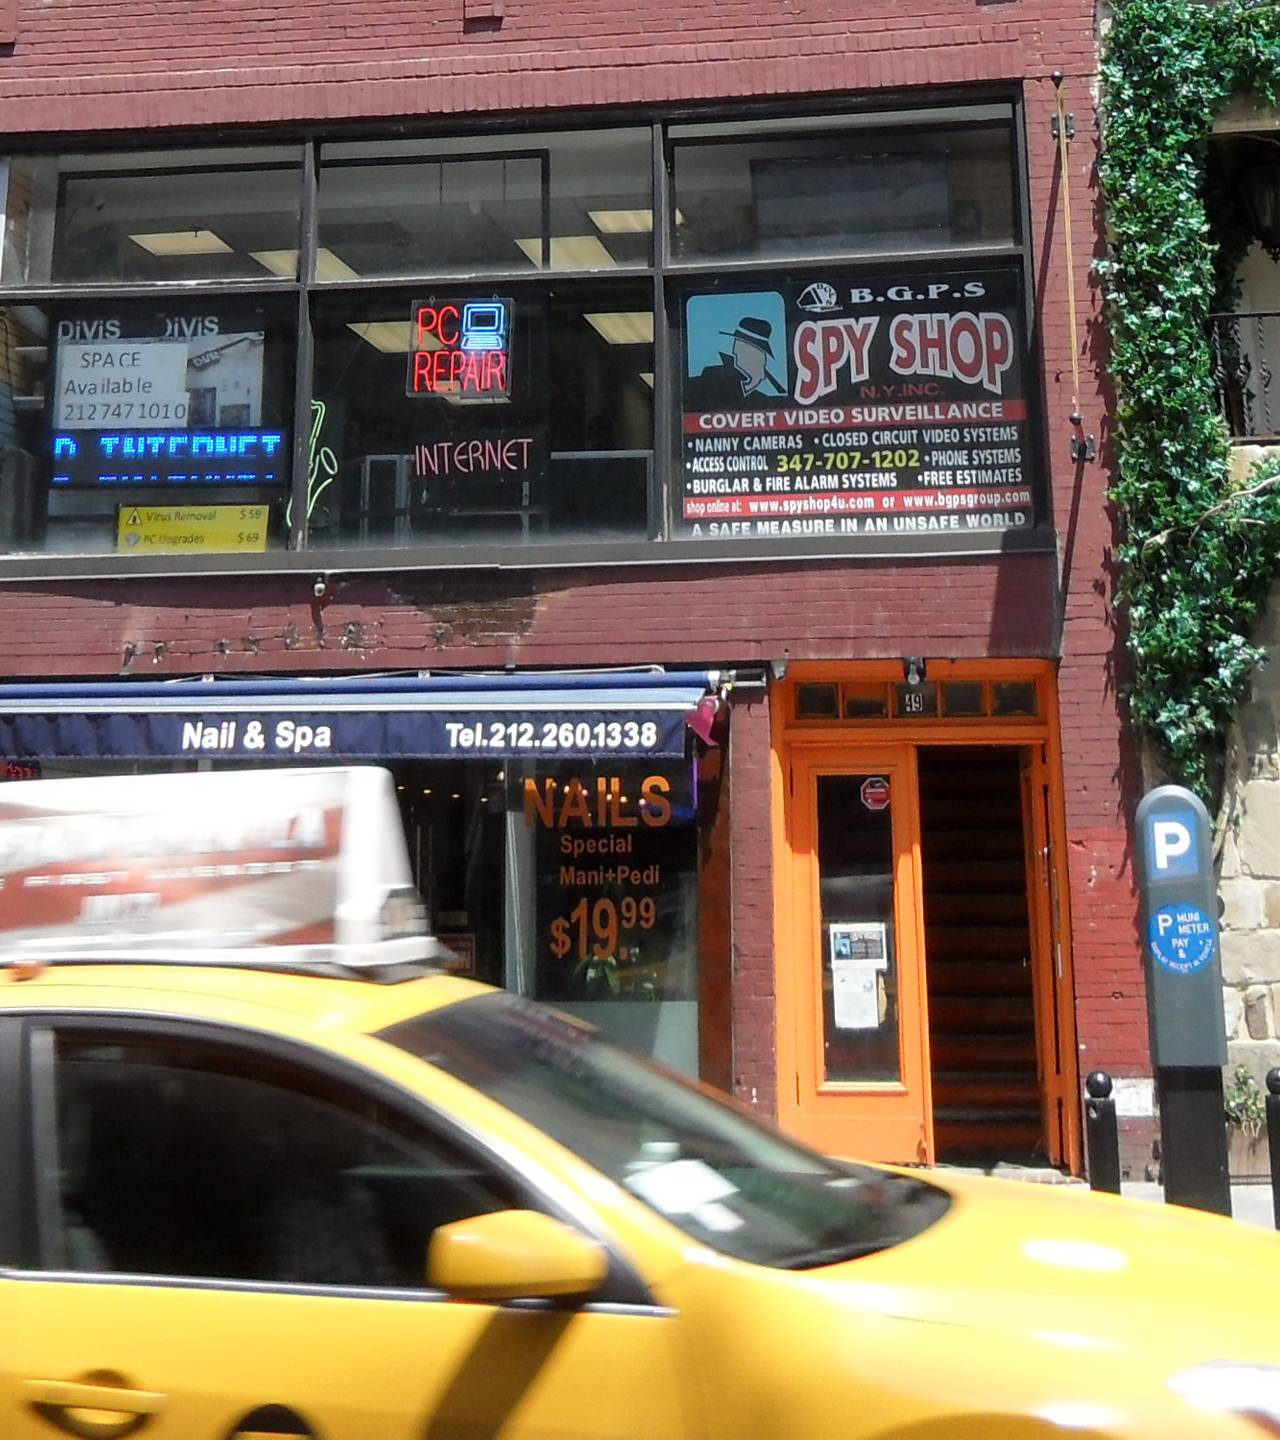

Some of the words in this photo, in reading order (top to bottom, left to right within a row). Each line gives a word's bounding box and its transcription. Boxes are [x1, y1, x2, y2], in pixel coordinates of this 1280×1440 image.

[850, 281, 986, 304] B.G.P.S
[416, 305, 460, 346] PC
[80, 351, 142, 369] SPACE
[793, 315, 881, 406] SPY
[888, 310, 1015, 396] SHOP
[414, 350, 507, 393] REPAIR
[63, 376, 153, 396] Available
[698, 411, 777, 429] COVERT
[783, 409, 845, 426] VIDEO
[851, 402, 1004, 423] SURVEILLANCE
[695, 437, 740, 453] NANNY
[743, 434, 803, 451] CAMERAS
[822, 430, 869, 448] CLOSED
[871, 428, 919, 446] CIRCUIT
[922, 427, 960, 444] VIDEO
[963, 425, 1019, 443] SYSTEMS
[415, 437, 534, 476] INTERNET
[692, 456, 725, 473] ACCESS
[726, 454, 769, 472] CONTROL
[776, 449, 921, 473] 347-707-1202
[931, 450, 969, 467] PHONE
[972, 447, 1022, 465] SYSTEMS
[693, 477, 750, 495] BURGLAR
[753, 476, 762, 492] &
[765, 476, 791, 491] FIRE
[794, 473, 839, 491] ALARM
[842, 471, 898, 490] SYSTEMS
[923, 470, 953, 487] FREE
[956, 467, 1023, 485] ESTIMATES
[686, 500, 705, 515] shop
[748, 495, 875, 515] www.spyshop4u.com
[882, 497, 895, 509] or
[903, 491, 1031, 511] www.bgpsgroup.com
[174, 510, 217, 522] Removal
[691, 523, 703, 537] A
[709, 521, 752, 537] SAFE
[756, 518, 835, 535] MEASURE
[841, 518, 858, 532] IN
[864, 517, 888, 532] AN
[893, 514, 960, 531] UNSAFE
[966, 511, 1026, 529] WORLD
[182, 721, 237, 750] Nail
[243, 720, 265, 749] &
[275, 720, 332, 753] Spa
[523, 775, 672, 829] NAILS
[559, 834, 633, 858] Special
[1154, 821, 1191, 869] P
[559, 864, 660, 886] Mani+Pedi
[1157, 913, 1173, 937] P
[1178, 922, 1210, 935] METER
[1171, 937, 1189, 948] PAY
